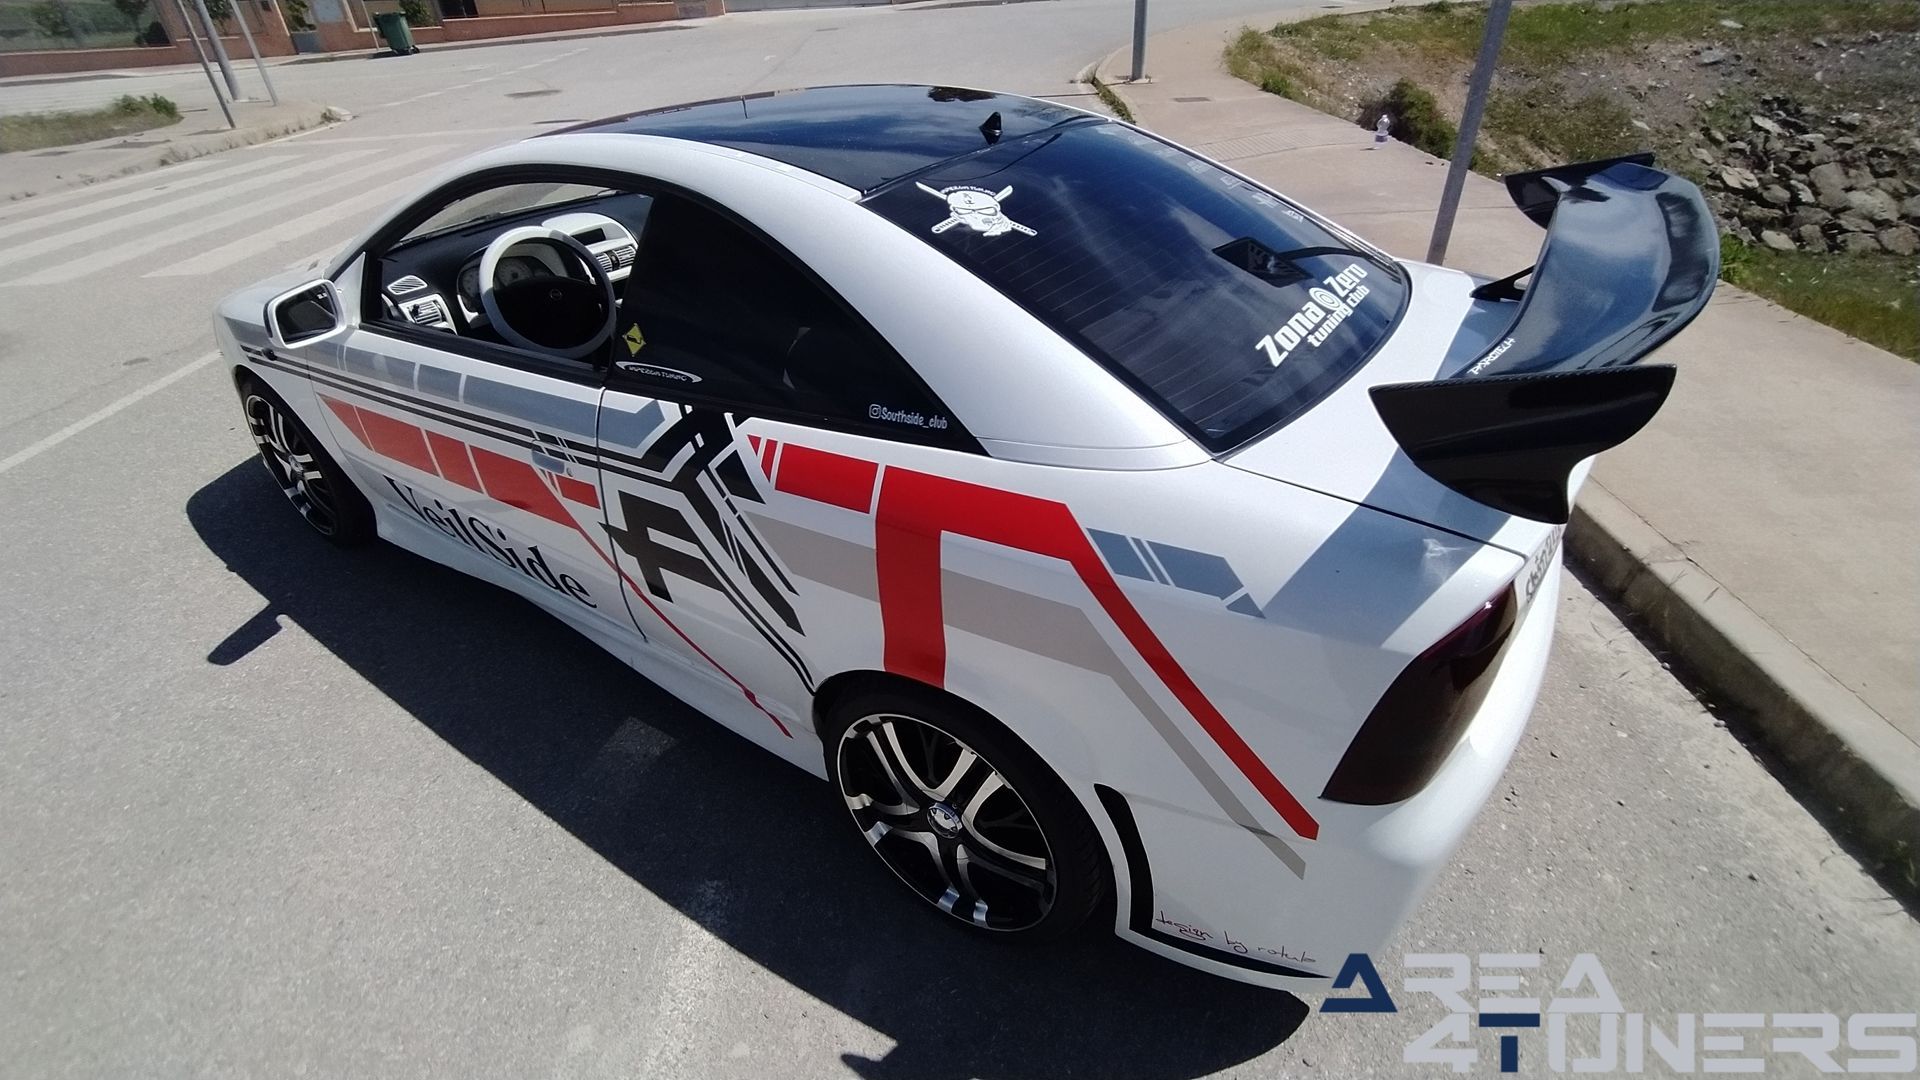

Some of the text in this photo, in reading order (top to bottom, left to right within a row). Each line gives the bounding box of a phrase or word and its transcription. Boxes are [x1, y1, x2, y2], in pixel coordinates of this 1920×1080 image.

[1255, 263, 1368, 367] Zona Zero
[1307, 285, 1370, 347] tuning club
[1224, 930, 1248, 954] by
